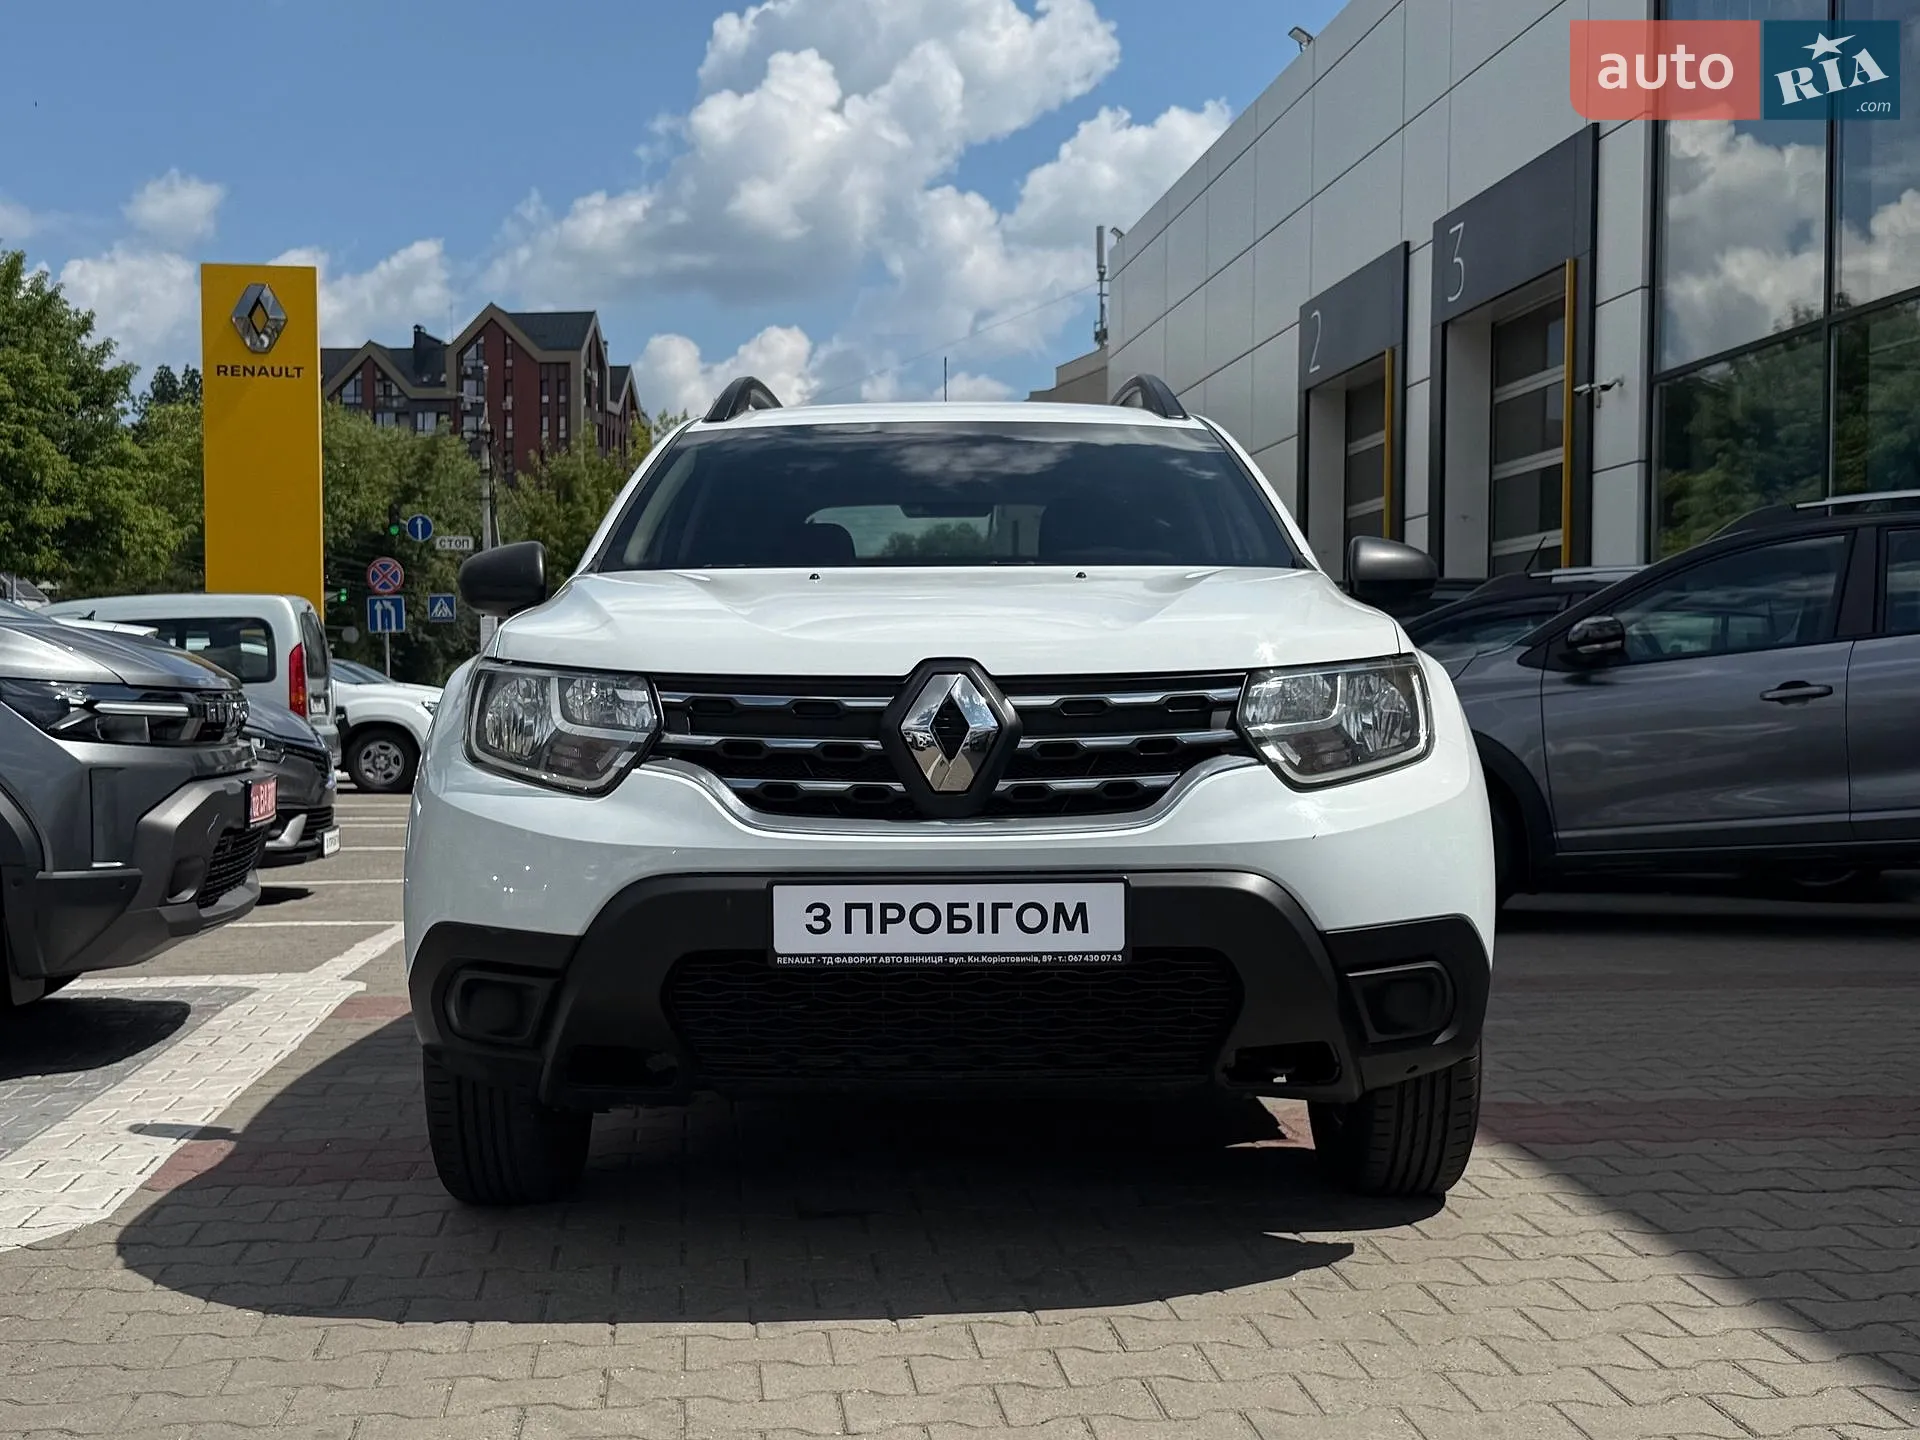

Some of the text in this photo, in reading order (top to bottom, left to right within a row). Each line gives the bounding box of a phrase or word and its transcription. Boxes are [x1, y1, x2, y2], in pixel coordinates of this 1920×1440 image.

[1447, 221, 1465, 302] 3
[1308, 309, 1322, 374] 2
[216, 364, 305, 379] RENAULT
[439, 538, 470, 549] СТОП
[843, 900, 1090, 936] ПРОБІГОМ
[776, 956, 817, 965] RENAULT
[821, 956, 834, 966] ТД
[834, 956, 877, 965] ФАВОРИТ
[878, 956, 903, 965] АВТО
[903, 955, 943, 965] ВІННИЦЯ
[949, 955, 967, 965] вул.
[1067, 954, 1083, 963] 067
[1083, 954, 1100, 963] 430
[1101, 954, 1112, 963] 07
[1112, 954, 1123, 963] 43
